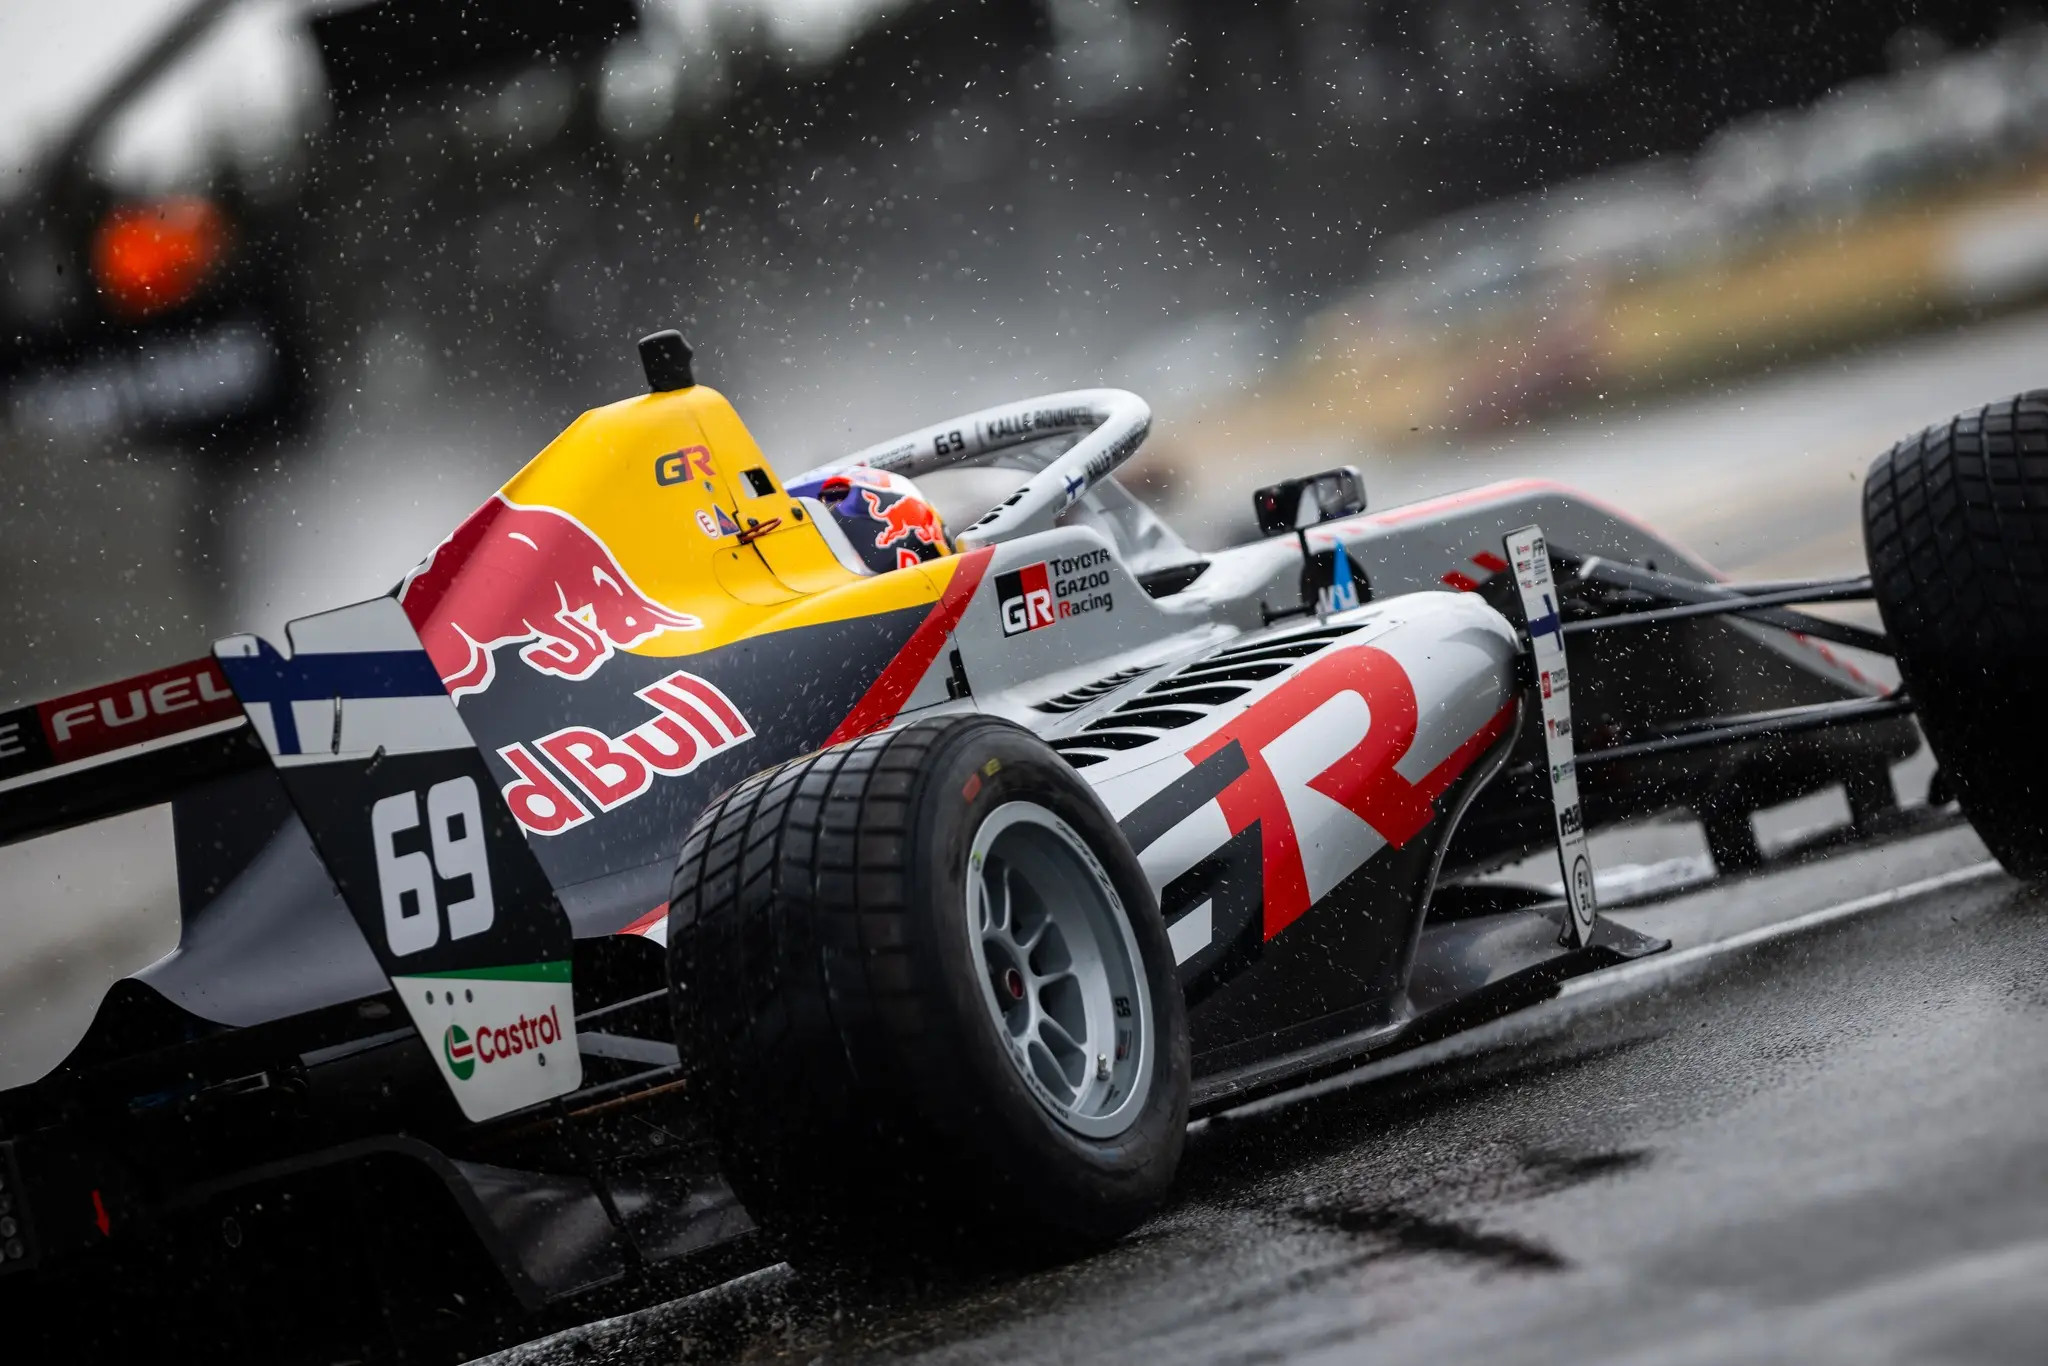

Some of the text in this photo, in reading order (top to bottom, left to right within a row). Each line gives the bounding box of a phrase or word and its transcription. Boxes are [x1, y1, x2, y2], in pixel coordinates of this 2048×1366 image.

[933, 430, 966, 456] 69
[985, 411, 1033, 439] KALLE
[655, 444, 717, 486] GR
[1049, 548, 1111, 576] TOYOTA
[1055, 570, 1110, 597] GAZOO
[1001, 588, 1054, 633] GR
[1058, 593, 1114, 618] Racing
[52, 671, 233, 742] FUEL
[371, 775, 495, 957] 69
[476, 1005, 562, 1064] Castrol
